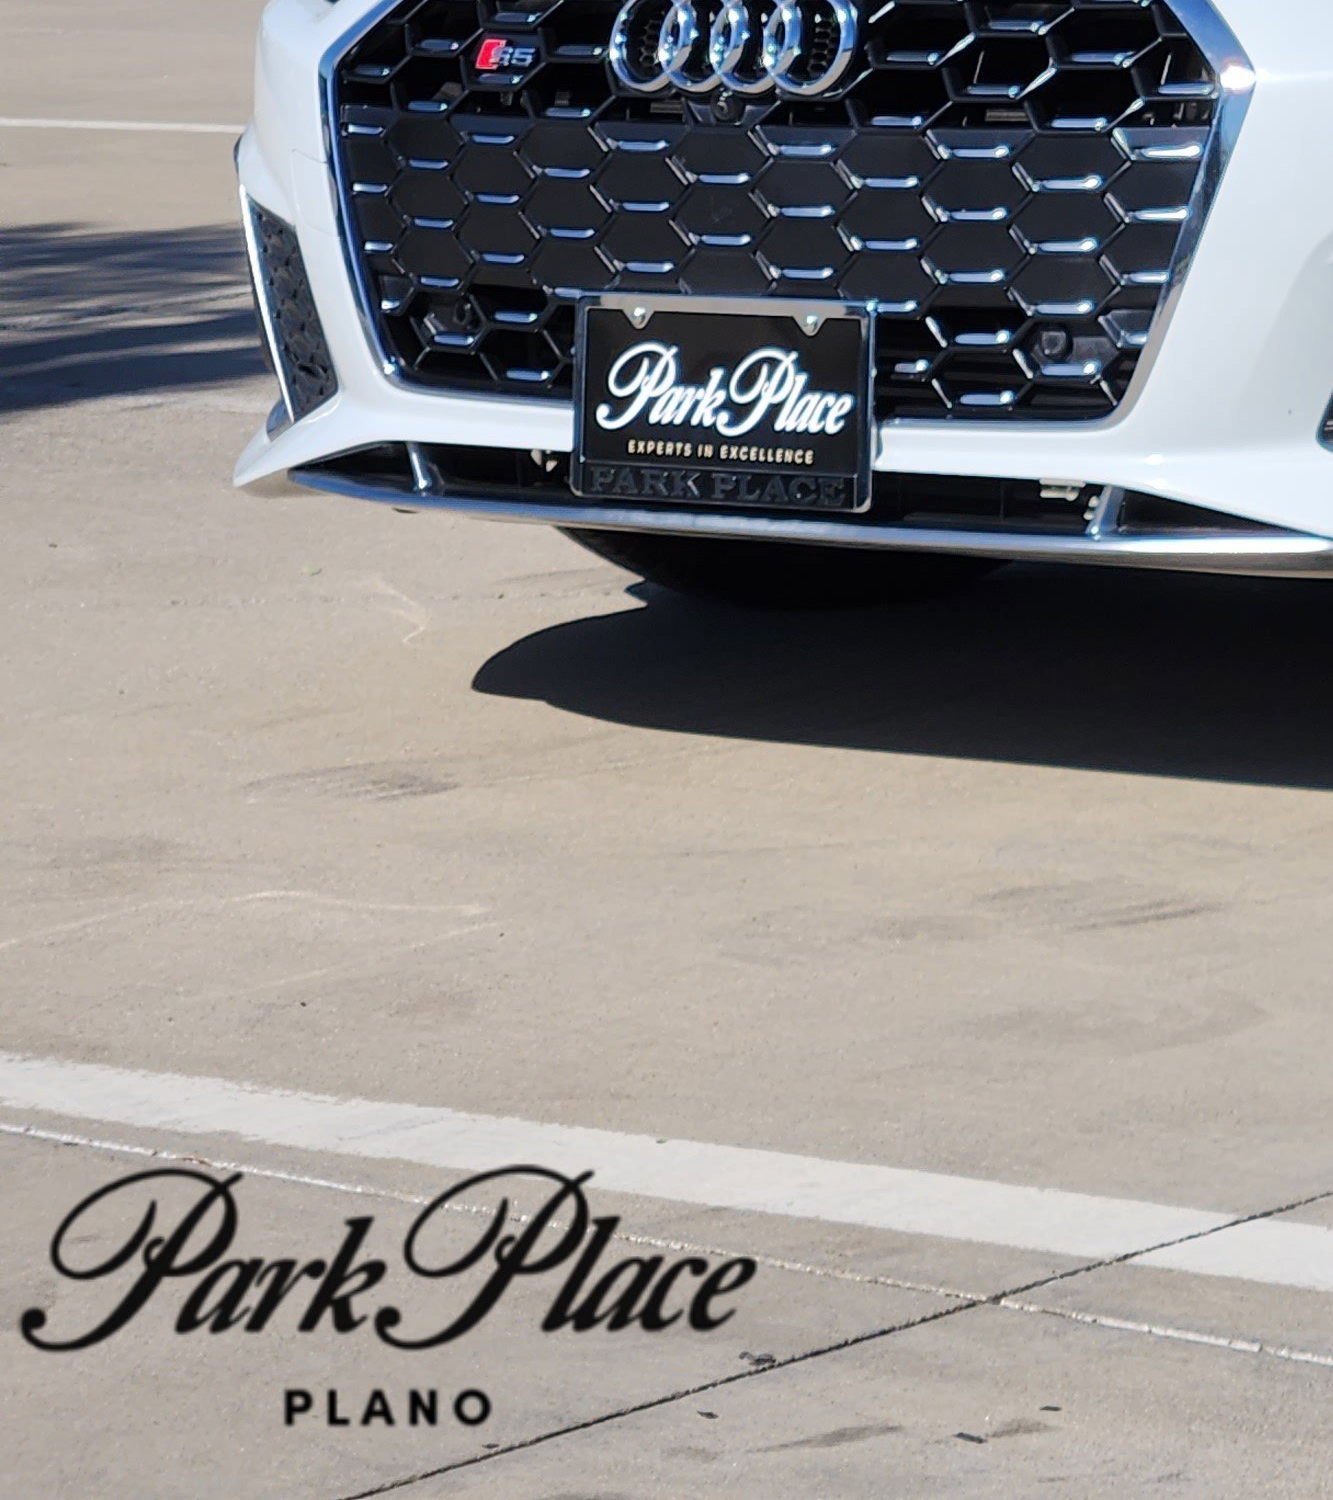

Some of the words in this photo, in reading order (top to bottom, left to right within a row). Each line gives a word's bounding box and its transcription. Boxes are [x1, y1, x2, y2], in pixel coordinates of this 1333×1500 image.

[486, 44, 537, 68] S5
[595, 341, 728, 431] Park
[715, 346, 855, 437] Place
[627, 438, 693, 458] EXPERTS
[697, 443, 714, 459] IN
[719, 445, 815, 465] EXCELLENCE
[589, 465, 701, 499] PARK
[710, 471, 846, 507] PLACE
